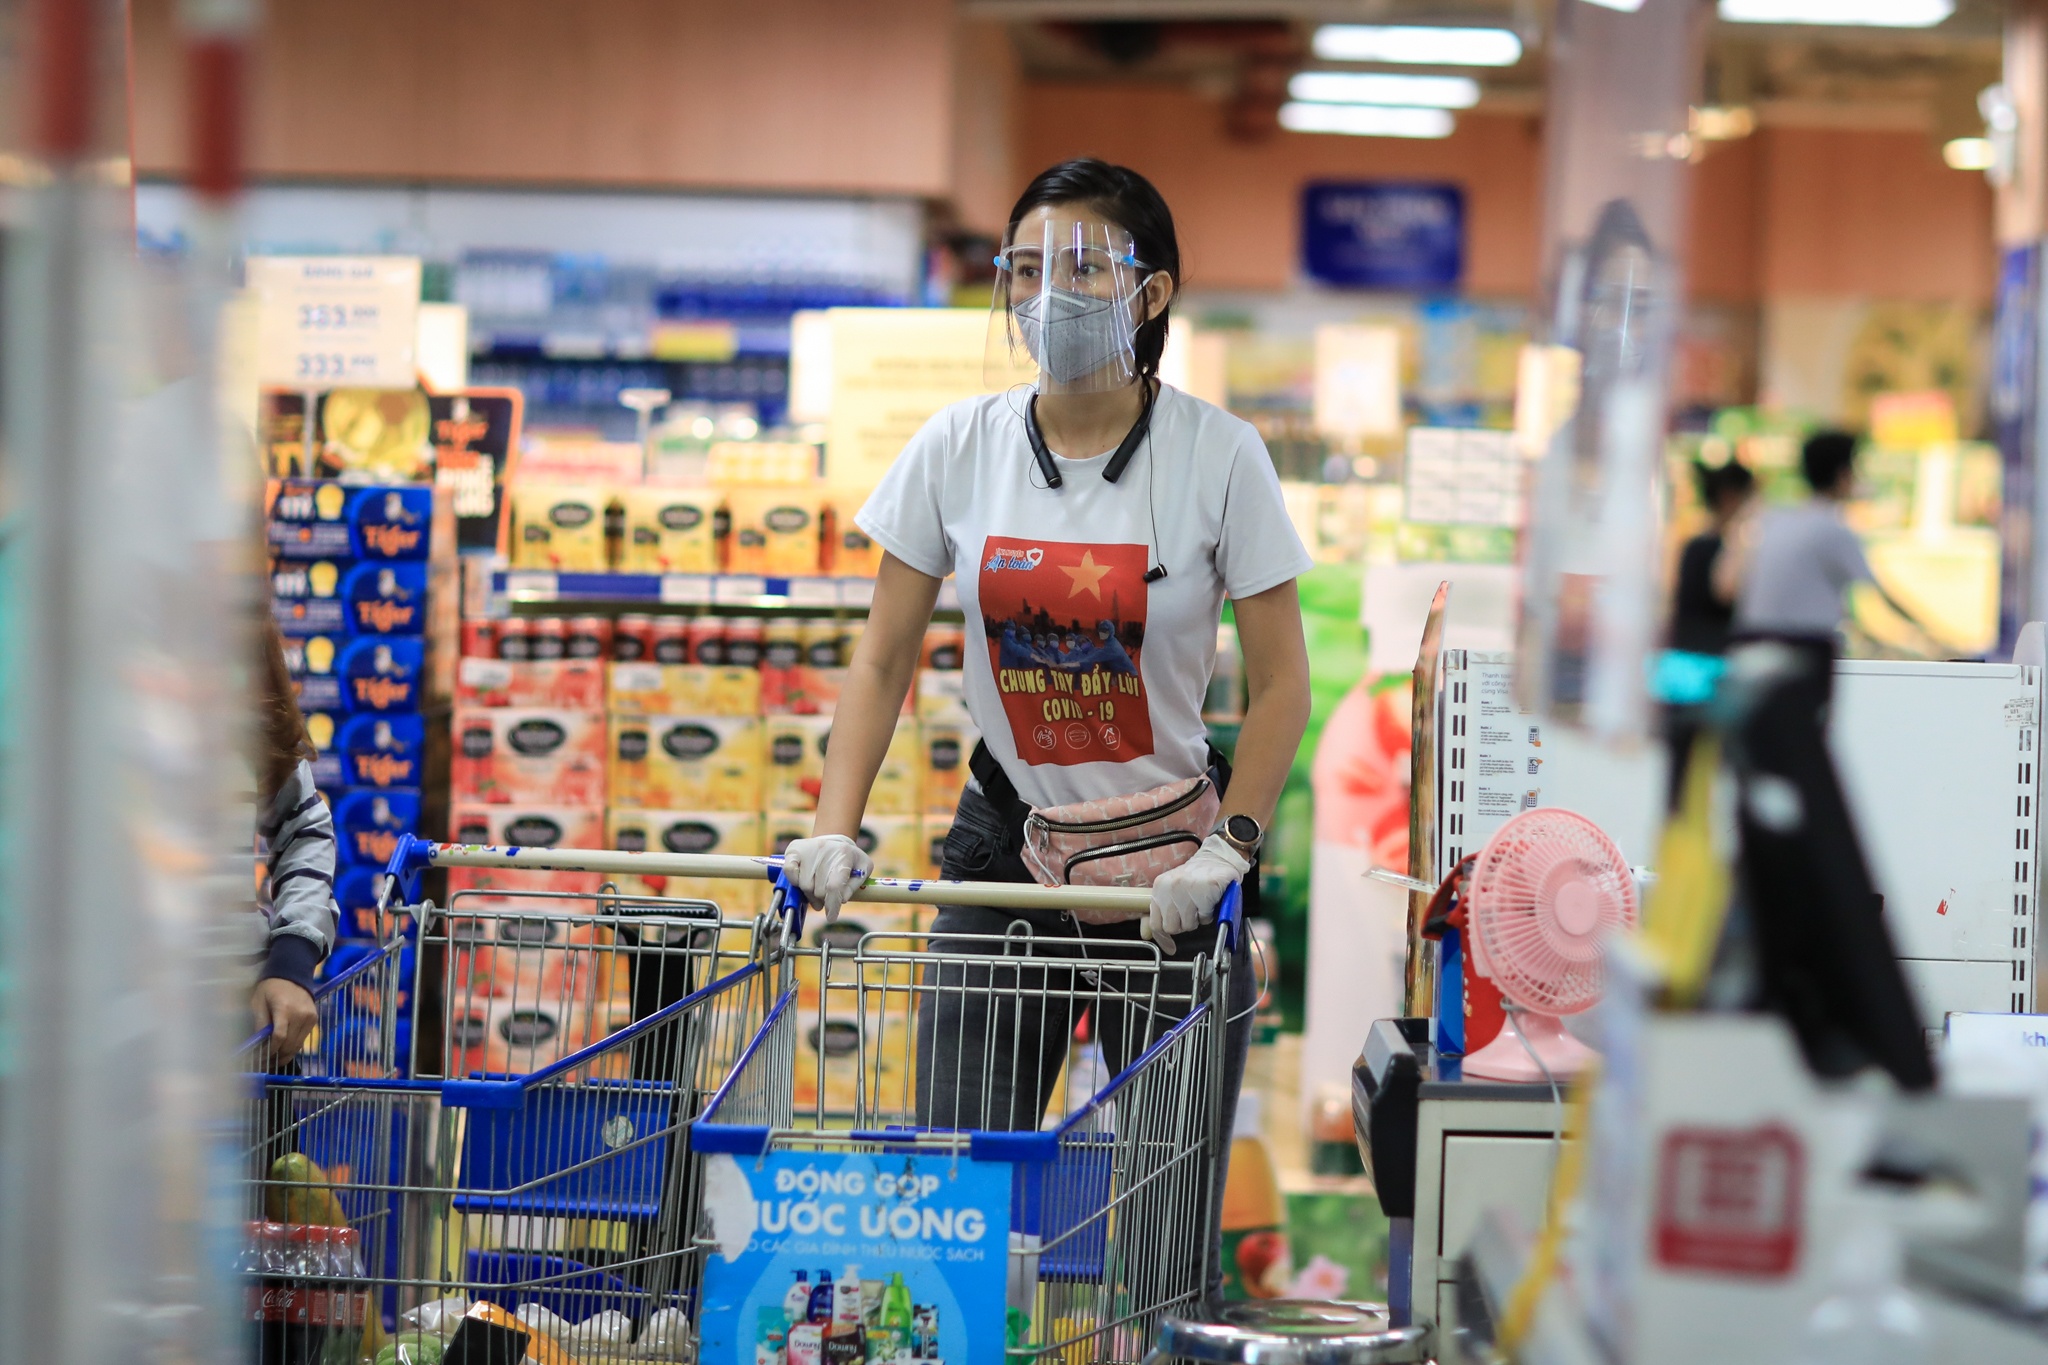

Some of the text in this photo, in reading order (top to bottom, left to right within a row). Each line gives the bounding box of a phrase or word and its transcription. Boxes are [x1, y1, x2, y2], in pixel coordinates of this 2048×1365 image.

[364, 525, 420, 557] Tiger
[357, 601, 413, 632] Tiger
[354, 678, 410, 709] Tiger
[1000, 669, 1046, 693] CHUNG
[1050, 670, 1073, 694] TAY
[1081, 664, 1111, 696] ĐẨY
[1099, 700, 1114, 721] 19
[355, 754, 413, 786] Tiger
[2022, 1031, 2048, 1048] kh
[776, 1163, 865, 1197] ĐÓNG
[859, 1197, 987, 1243] UỐNG
